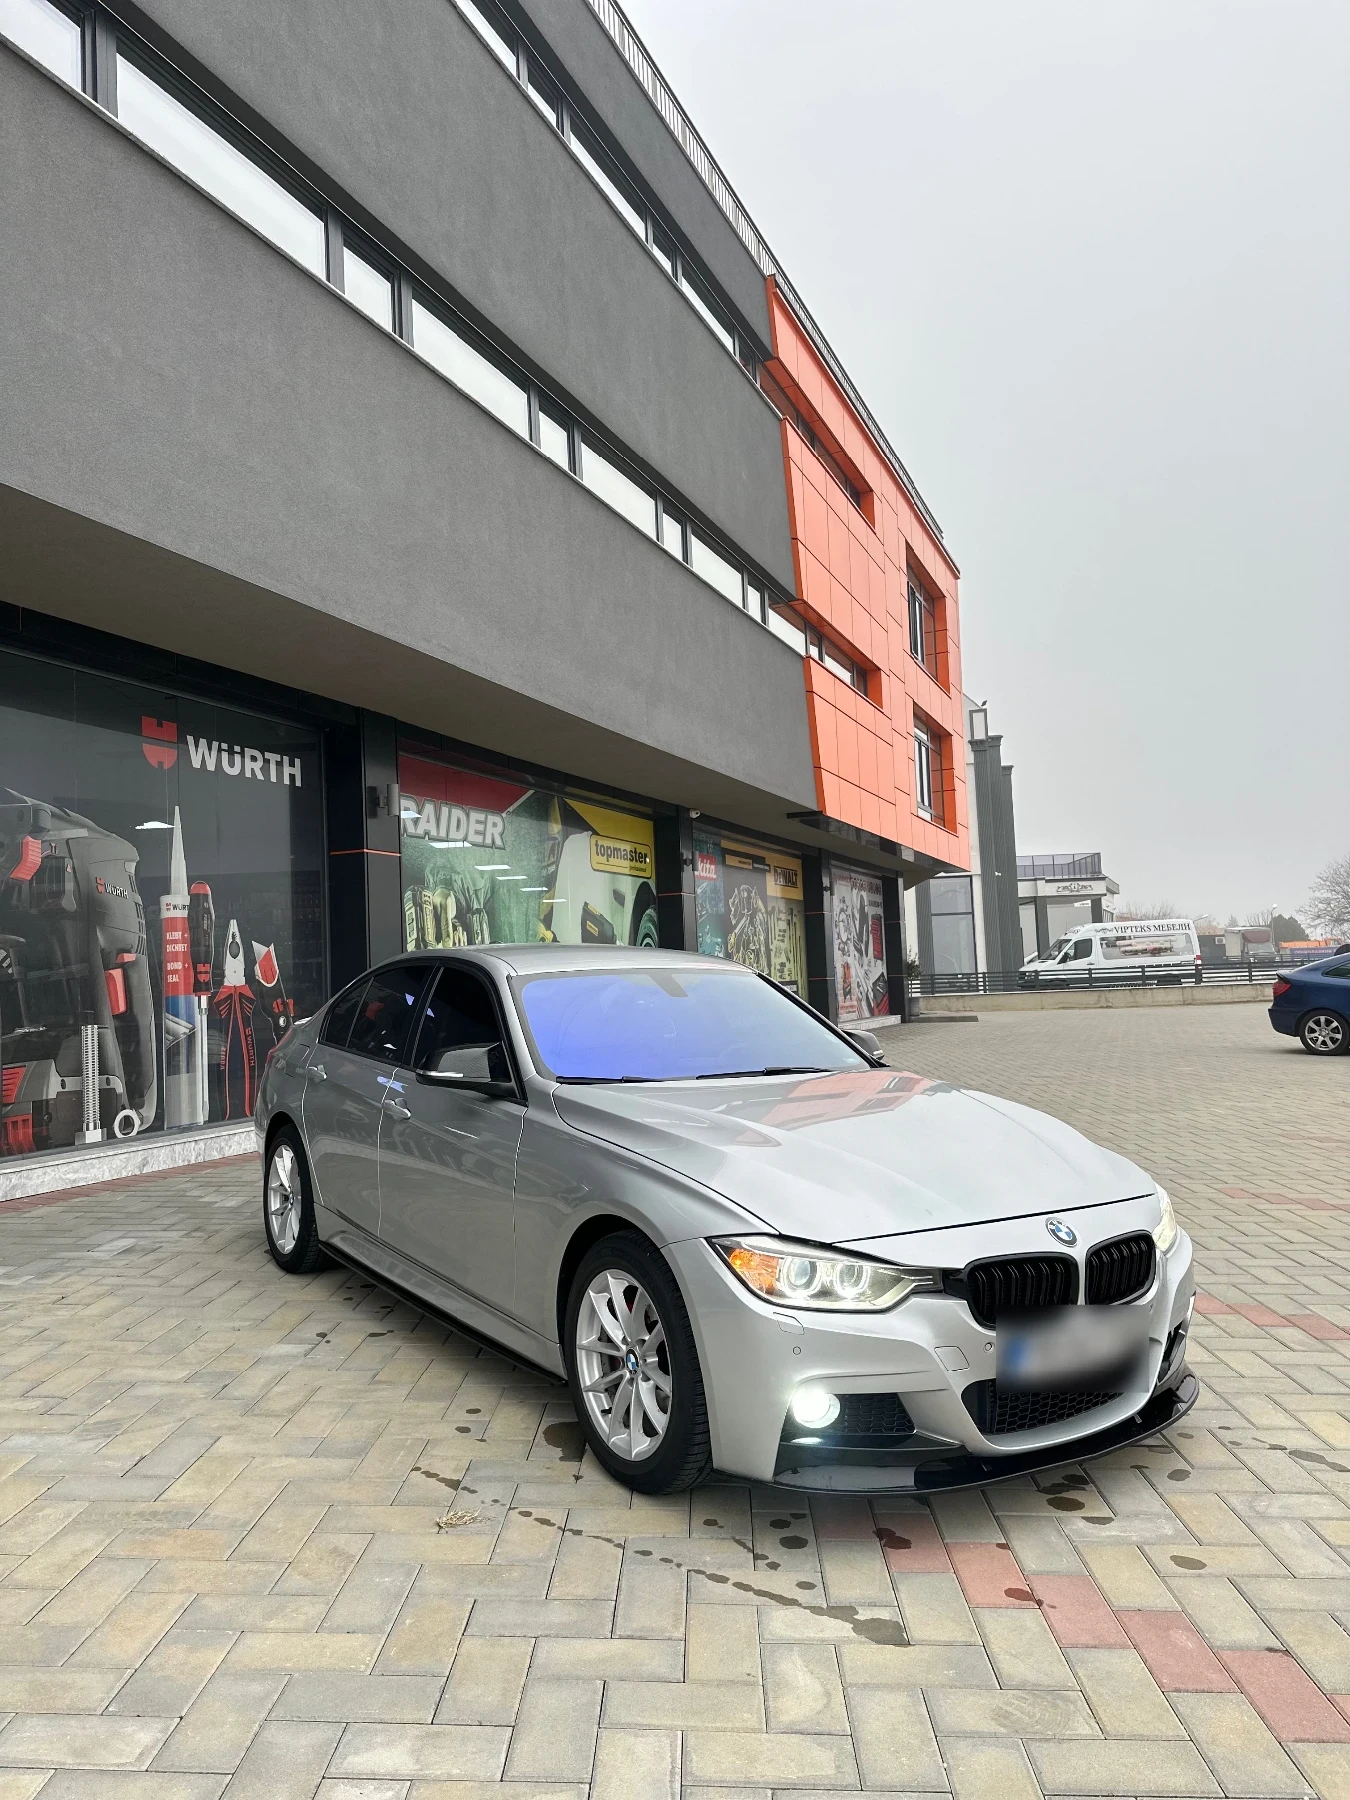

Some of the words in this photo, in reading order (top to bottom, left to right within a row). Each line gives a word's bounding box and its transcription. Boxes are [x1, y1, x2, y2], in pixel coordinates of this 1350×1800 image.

[186, 735, 302, 787] WÜRTH
[400, 793, 506, 850] RAIDER
[594, 840, 649, 865] topmaster
[694, 857, 717, 879] kita
[104, 883, 129, 899] WÜRTH
[1114, 924, 1152, 934] VIPTEKS
[1152, 922, 1191, 932] МЕБЕЛИ
[166, 943, 188, 953] DICHTET
[167, 961, 183, 971] BOND
[167, 974, 180, 983] SEAL
